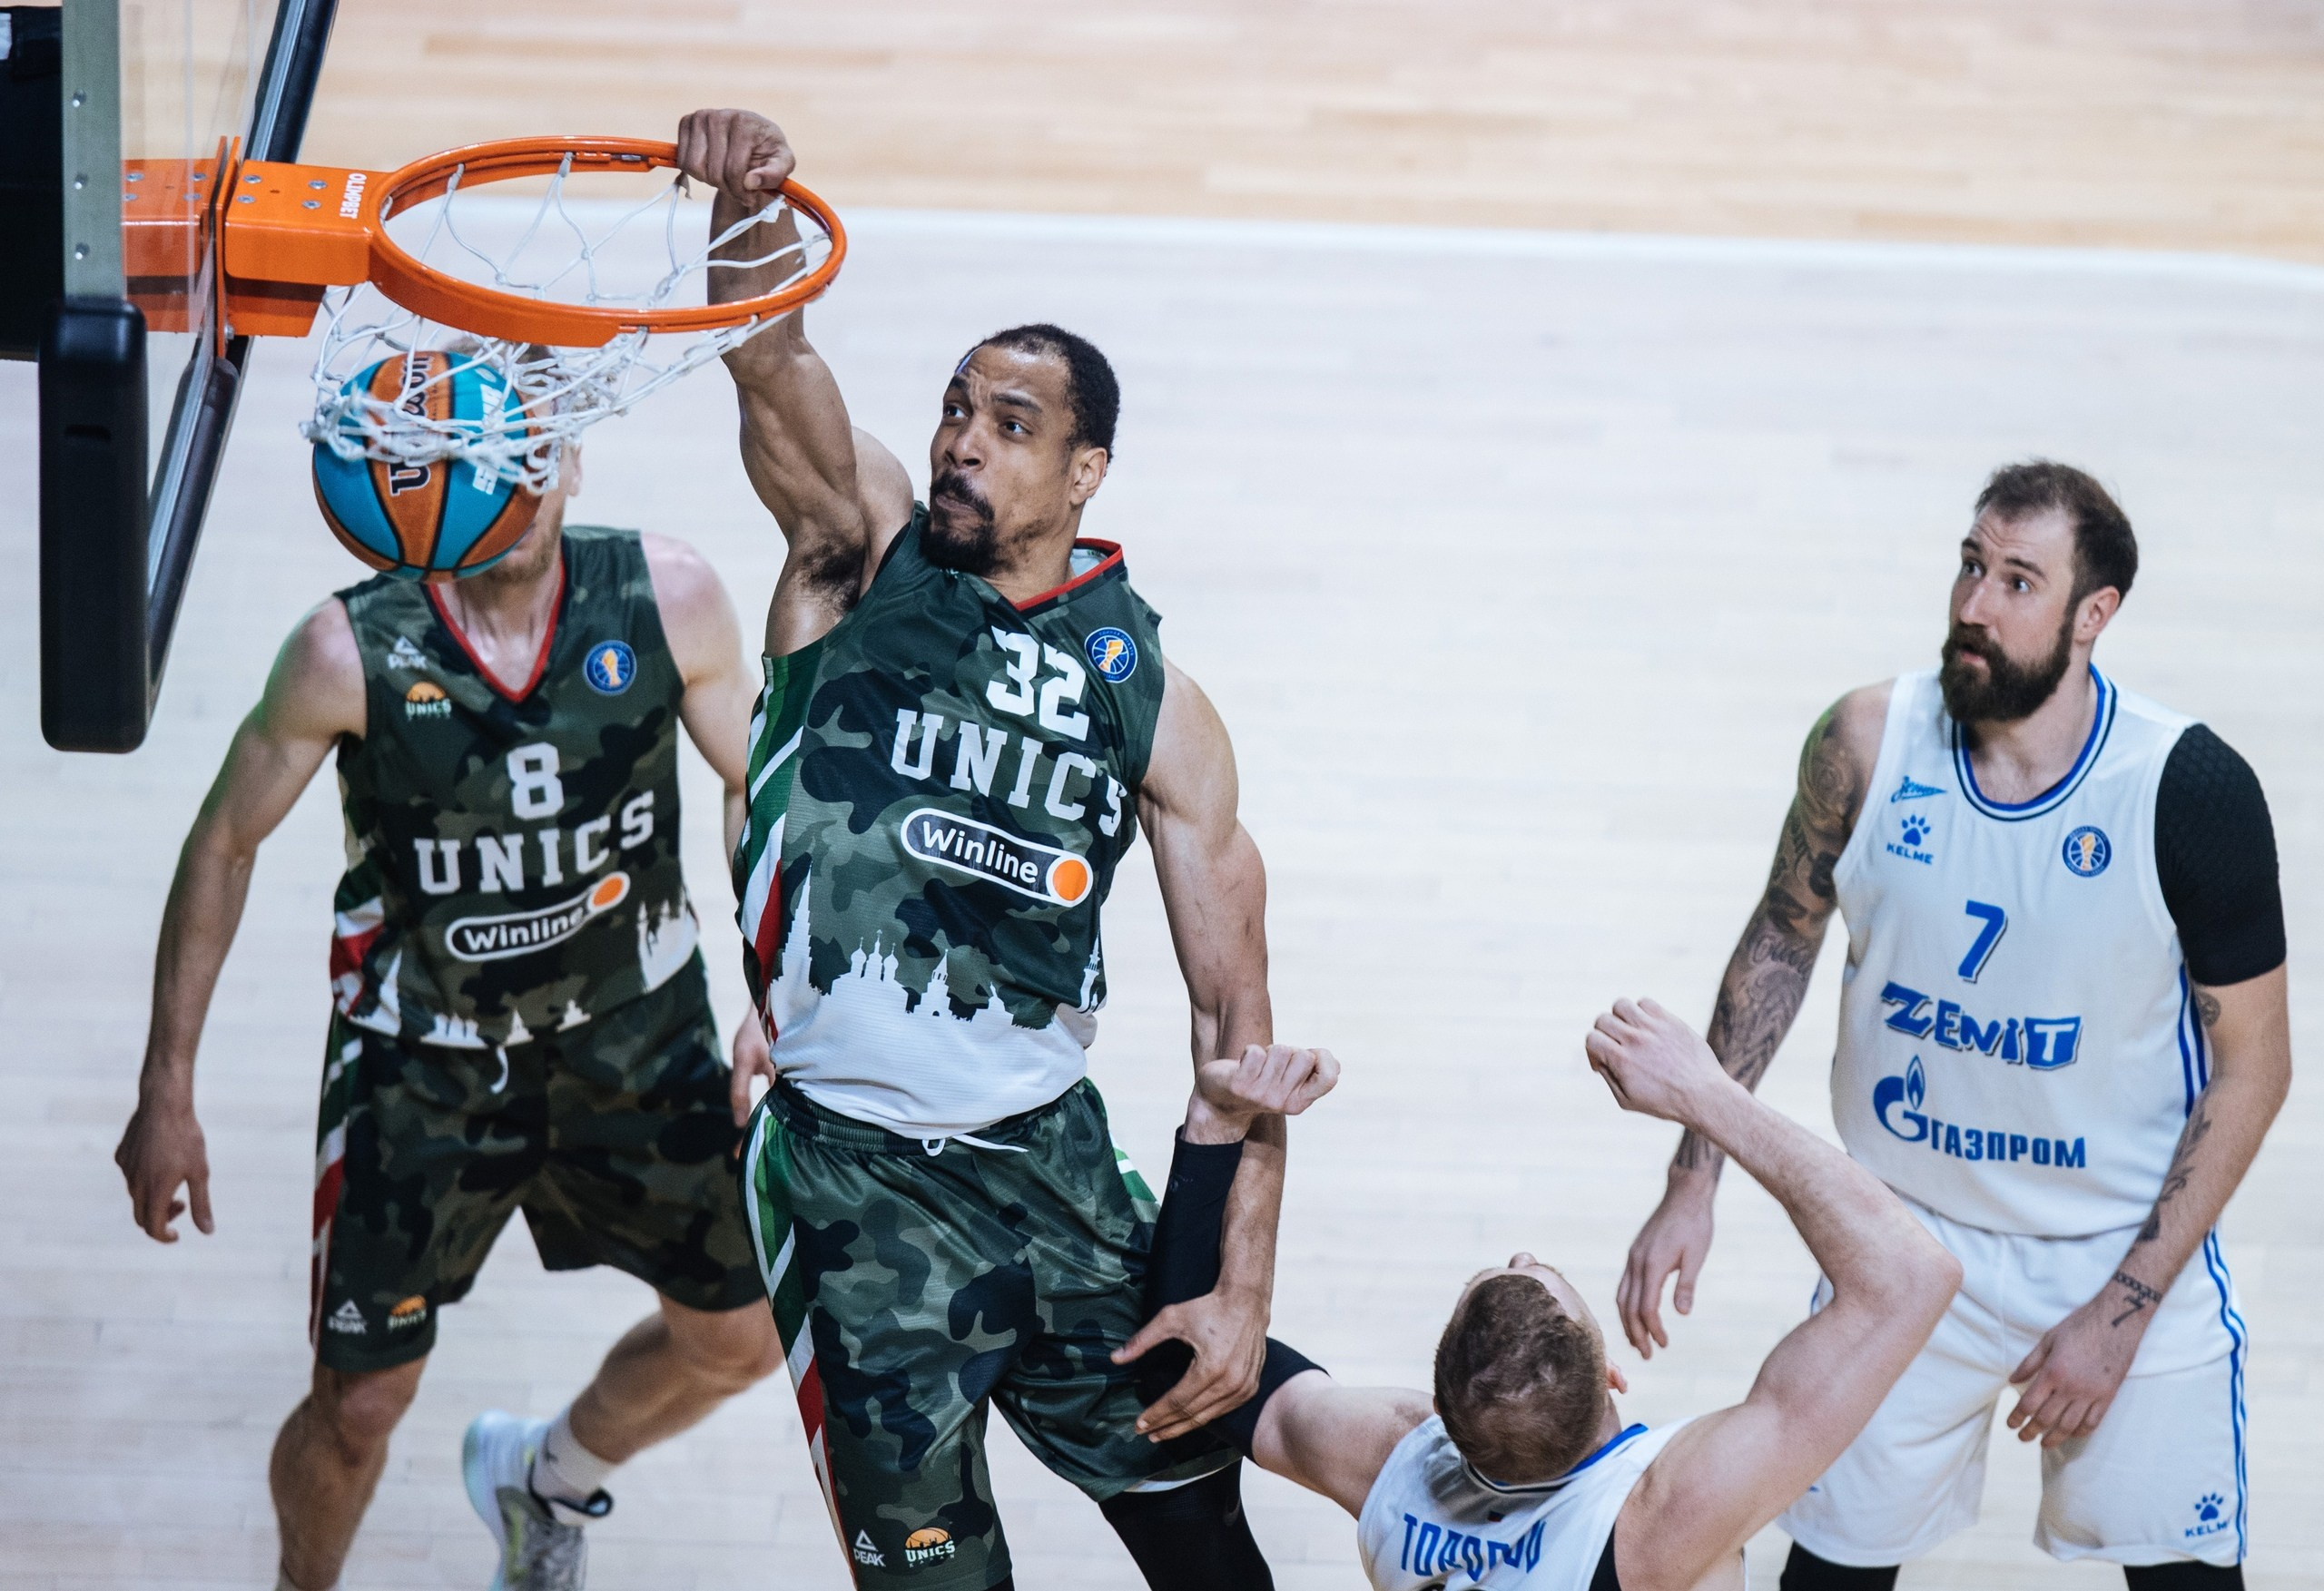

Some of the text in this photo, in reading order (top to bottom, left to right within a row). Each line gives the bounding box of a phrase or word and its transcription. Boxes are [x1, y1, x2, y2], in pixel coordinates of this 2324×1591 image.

[986, 625, 1090, 741] 32
[506, 741, 565, 820] 8
[891, 708, 1128, 838] UNICS
[413, 790, 655, 895] UNICS
[922, 820, 1039, 883] Winline
[1886, 842, 1935, 866] KELME
[463, 907, 588, 951] Winline
[1957, 899, 2008, 984] 7
[1931, 1117, 2086, 1169] ГАЗПРОМ
[853, 1547, 887, 1568] PEAK
[905, 1540, 956, 1563] UNICS
